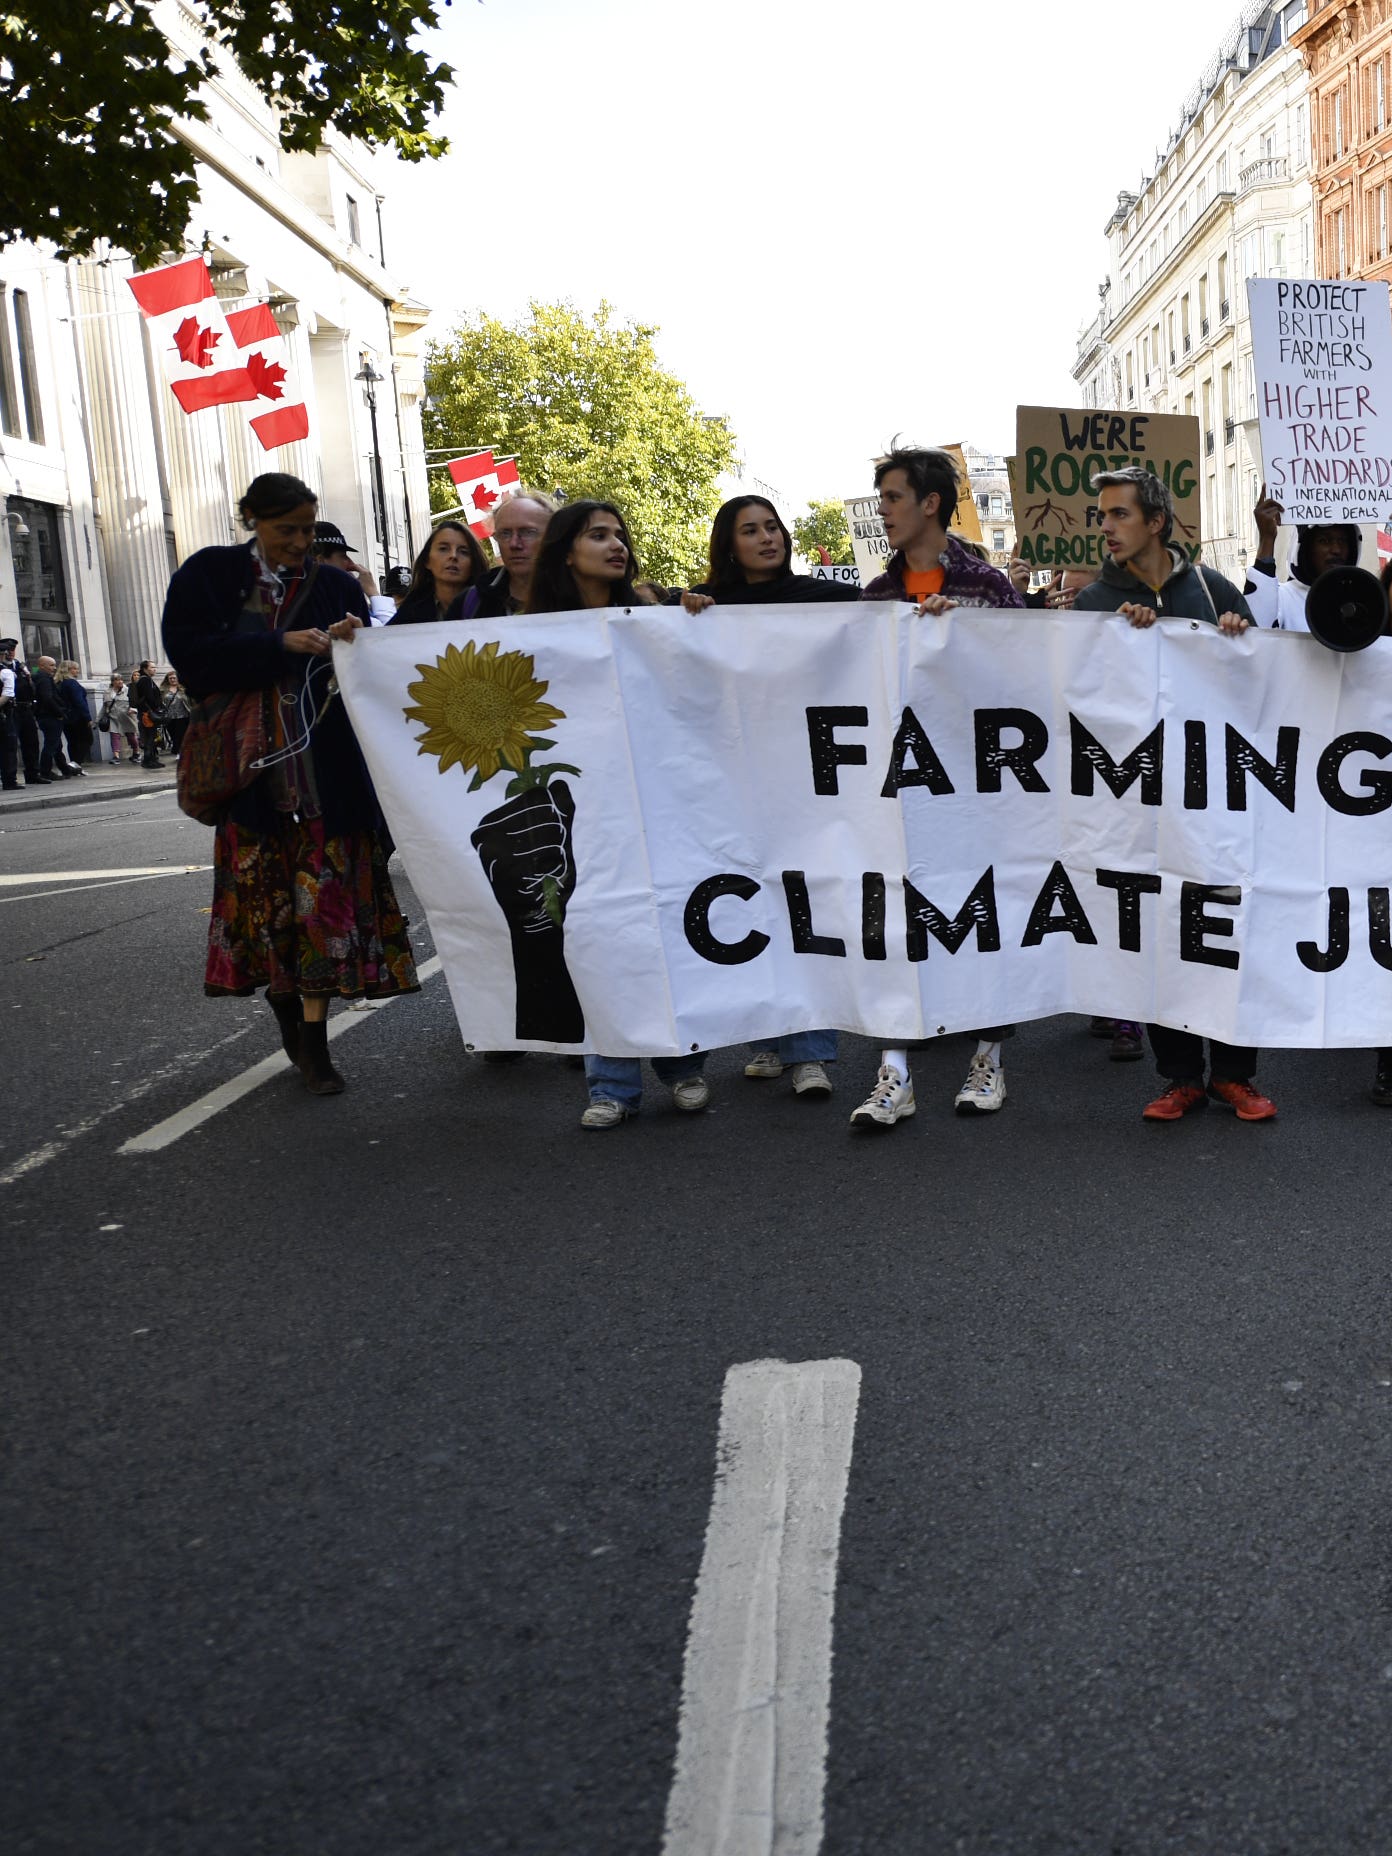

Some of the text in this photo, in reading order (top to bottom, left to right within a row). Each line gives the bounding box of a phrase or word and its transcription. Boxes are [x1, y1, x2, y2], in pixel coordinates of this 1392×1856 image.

[1278, 282, 1367, 313] PROTECT
[1278, 311, 1365, 341] BRITISH
[1280, 339, 1372, 371] FARMERS
[1304, 369, 1336, 381] WITH
[1264, 382, 1377, 420] HIGHER
[1059, 413, 1150, 452] WE'RE
[1287, 423, 1367, 456] TRADE
[1025, 446, 1198, 499] ROOTNG
[1270, 488, 1283, 500] IN
[1288, 505, 1379, 519] TRADE DEALS
[817, 569, 827, 580] A
[684, 861, 1241, 970] CLIMATE
